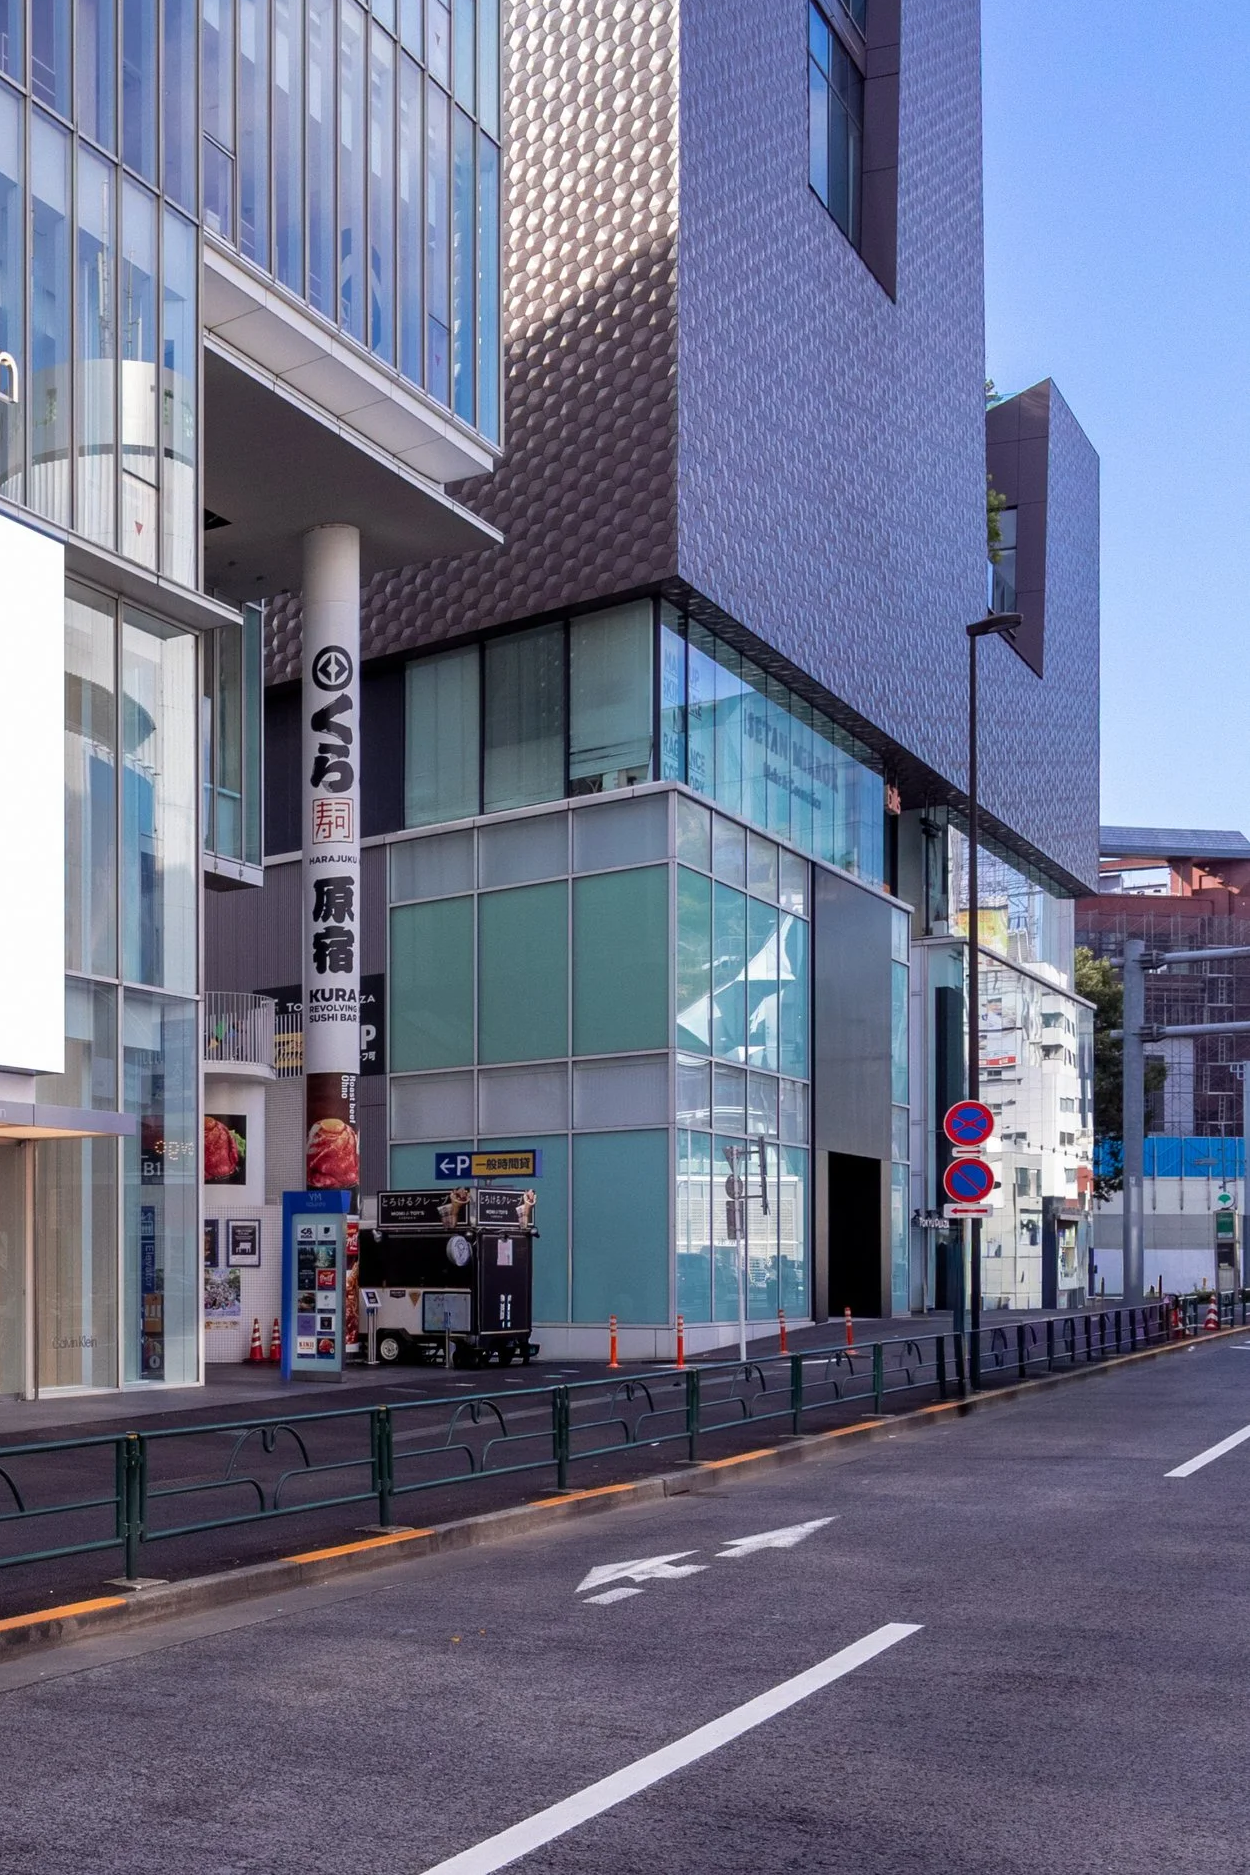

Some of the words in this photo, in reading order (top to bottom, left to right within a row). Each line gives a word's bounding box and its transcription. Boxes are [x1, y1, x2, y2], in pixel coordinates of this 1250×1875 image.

[309, 855, 358, 866] HARAJUKU
[312, 875, 355, 974] 原宿
[309, 988, 357, 1003] KURA
[309, 1003, 358, 1013] REVOLVING
[309, 1013, 338, 1023] SUSHI
[340, 1013, 358, 1023] BAR
[360, 1024, 377, 1050] P
[143, 1161, 162, 1176] B1
[456, 1155, 470, 1176] P
[475, 1157, 531, 1171] 一般時間貸
